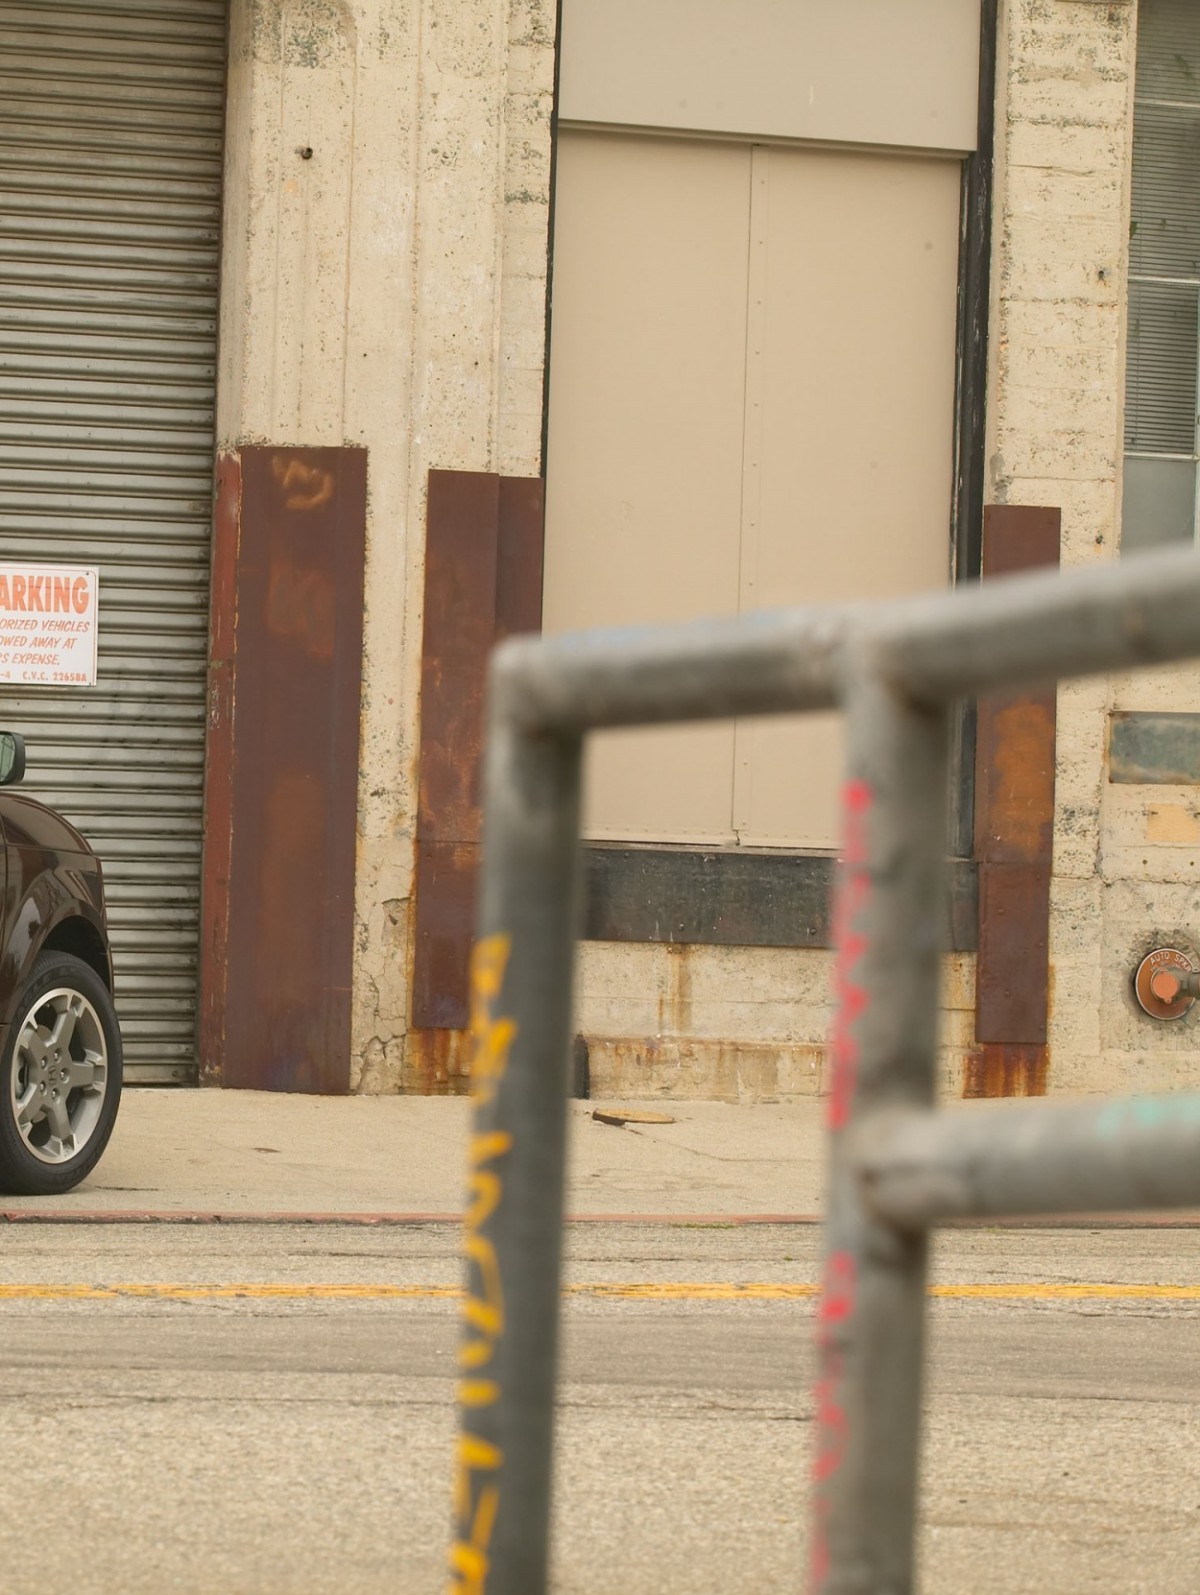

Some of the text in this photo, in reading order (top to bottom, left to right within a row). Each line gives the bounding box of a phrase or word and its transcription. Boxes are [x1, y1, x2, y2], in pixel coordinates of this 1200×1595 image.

[41, 620, 90, 633] VEHICLES
[29, 636, 62, 648] AWAY
[62, 637, 78, 649] AT
[11, 653, 61, 666] EXPENSE.
[22, 671, 48, 681] C.V.C.
[1150, 951, 1170, 965] AUTO
